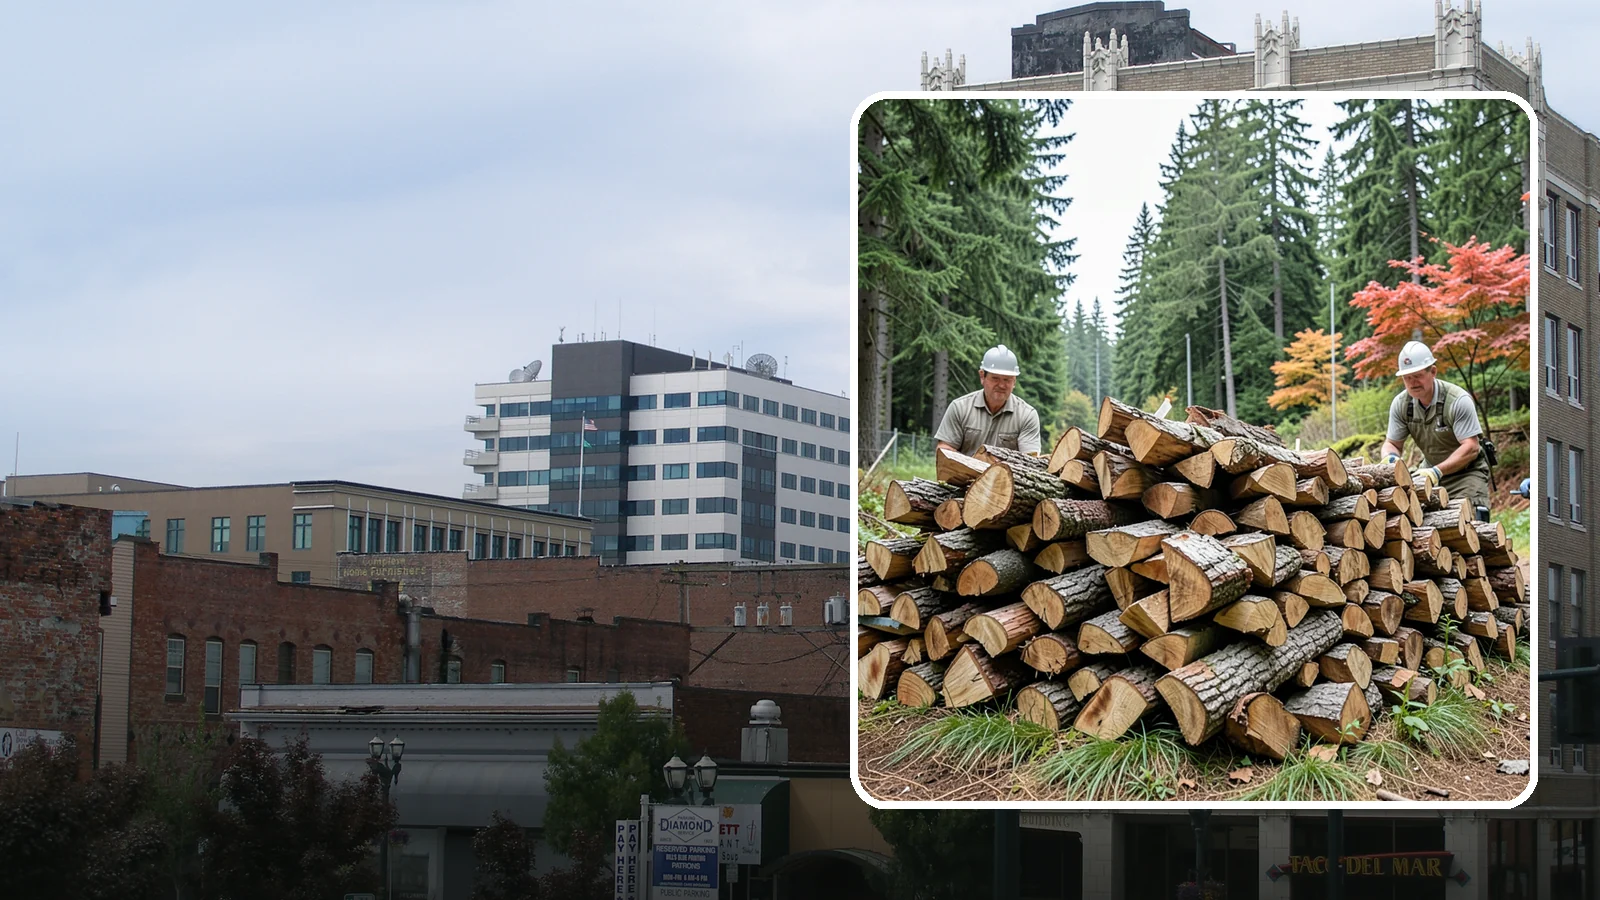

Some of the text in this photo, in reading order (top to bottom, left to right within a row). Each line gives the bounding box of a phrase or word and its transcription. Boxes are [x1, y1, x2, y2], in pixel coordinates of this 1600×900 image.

[343, 565, 427, 577] Home Furnishers
[660, 818, 713, 833] DIAMOND
[1022, 815, 1070, 828] BUILDING
[656, 845, 716, 854] RESERVED PARKING
[616, 825, 625, 894] PAY HERE
[627, 824, 637, 894] PAY HERE
[721, 851, 739, 862] Soup
[671, 862, 701, 870] PATRONS
[1290, 855, 1443, 877] TAC DEL MAR
[660, 888, 710, 898] PUBLIC PARKING
